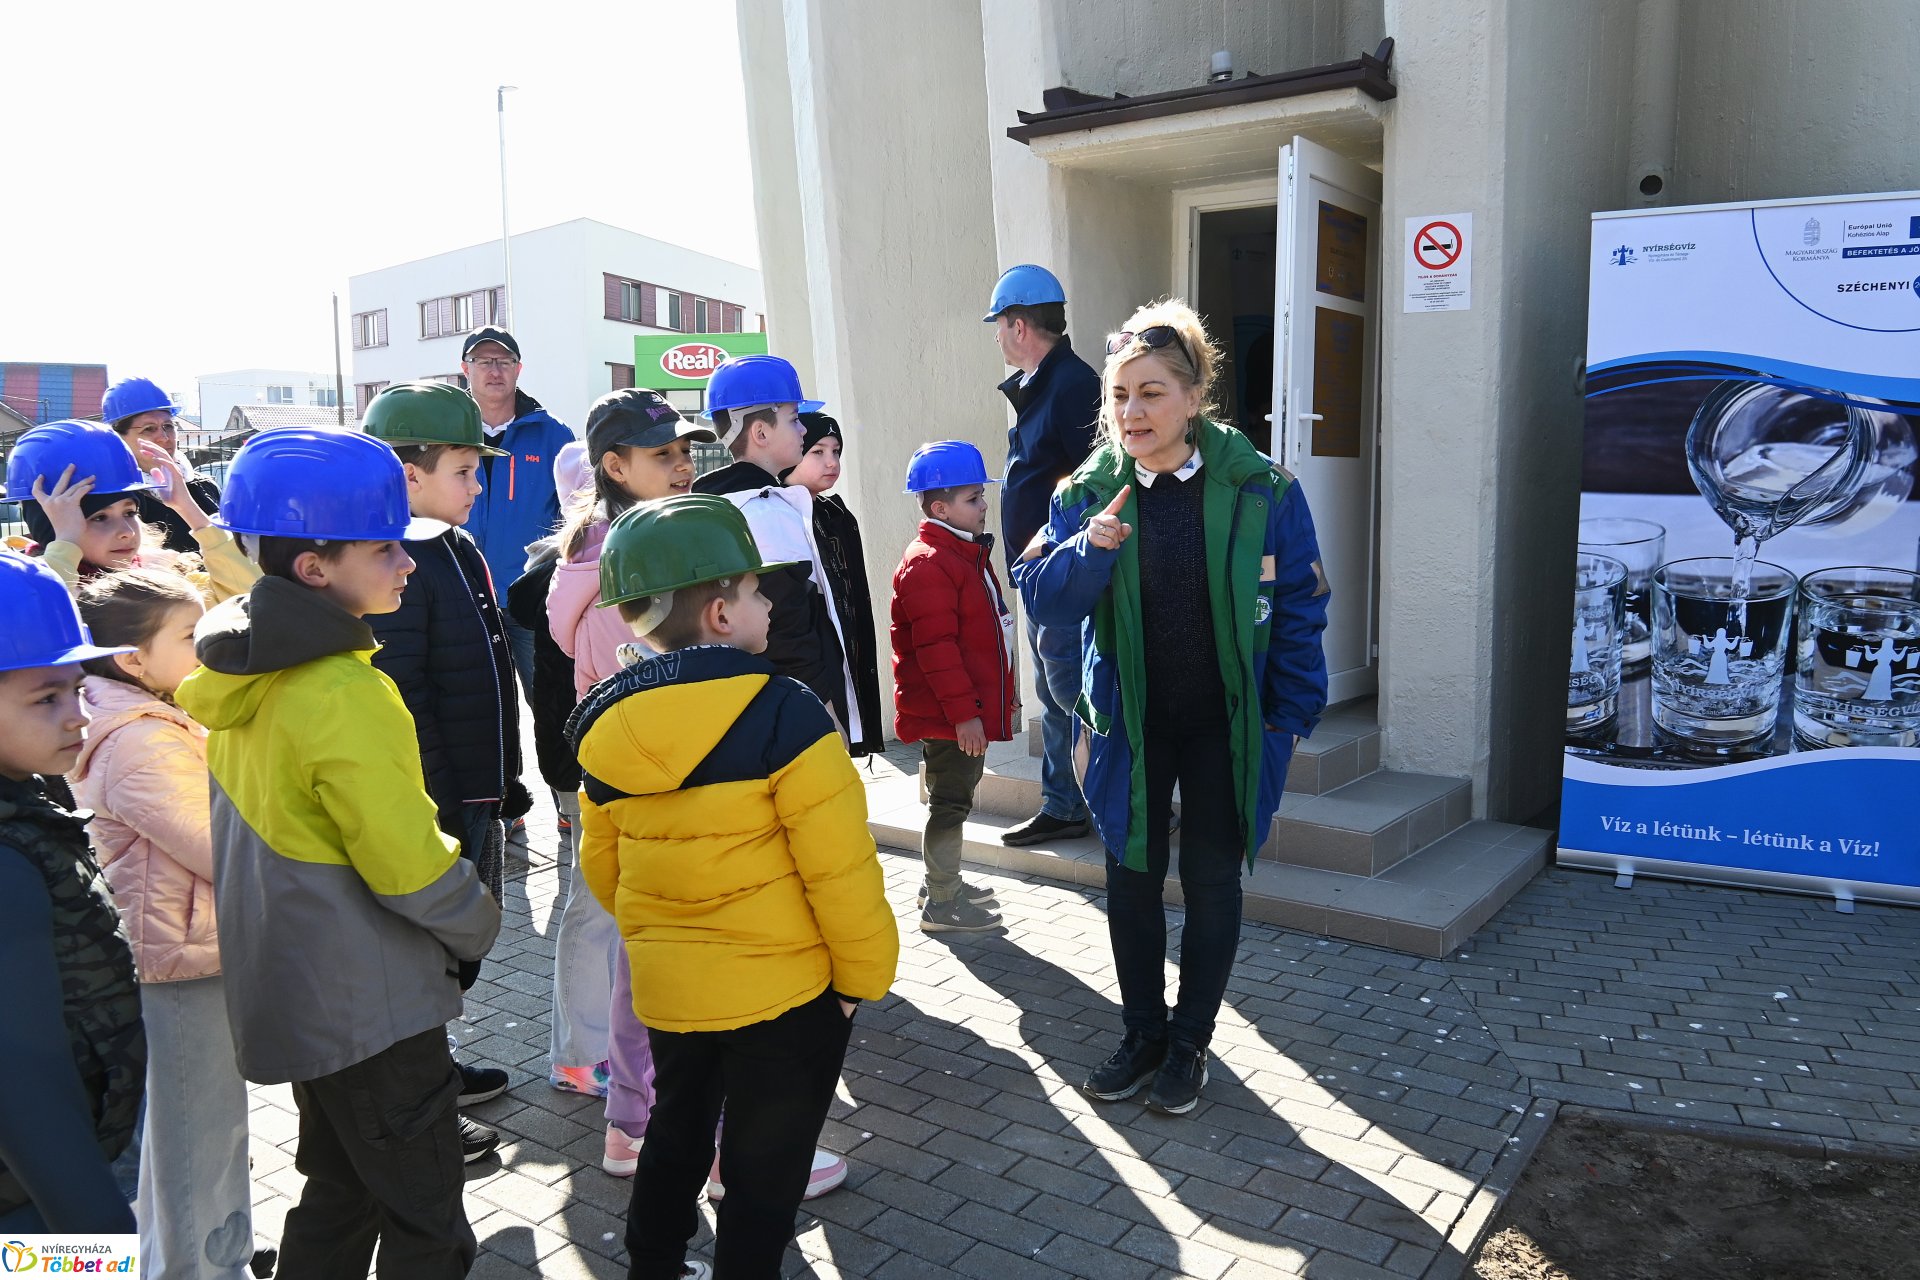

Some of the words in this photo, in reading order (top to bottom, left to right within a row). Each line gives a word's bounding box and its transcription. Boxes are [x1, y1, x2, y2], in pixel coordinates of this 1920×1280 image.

[1642, 242, 1696, 252] NYÍRSÉGVÍZ
[1785, 248, 1838, 256] MAGYARORSZÁG
[1847, 247, 1898, 256] BEFEKTETÉS
[1837, 281, 1910, 292] SZÉCHENYI
[668, 347, 715, 370] Reál
[1600, 815, 1631, 833] Víz
[1636, 822, 1648, 835] a
[1653, 820, 1722, 842] létünk
[1743, 829, 1815, 851] létünk
[1819, 839, 1832, 853] a
[1837, 838, 1880, 857] Víz!
